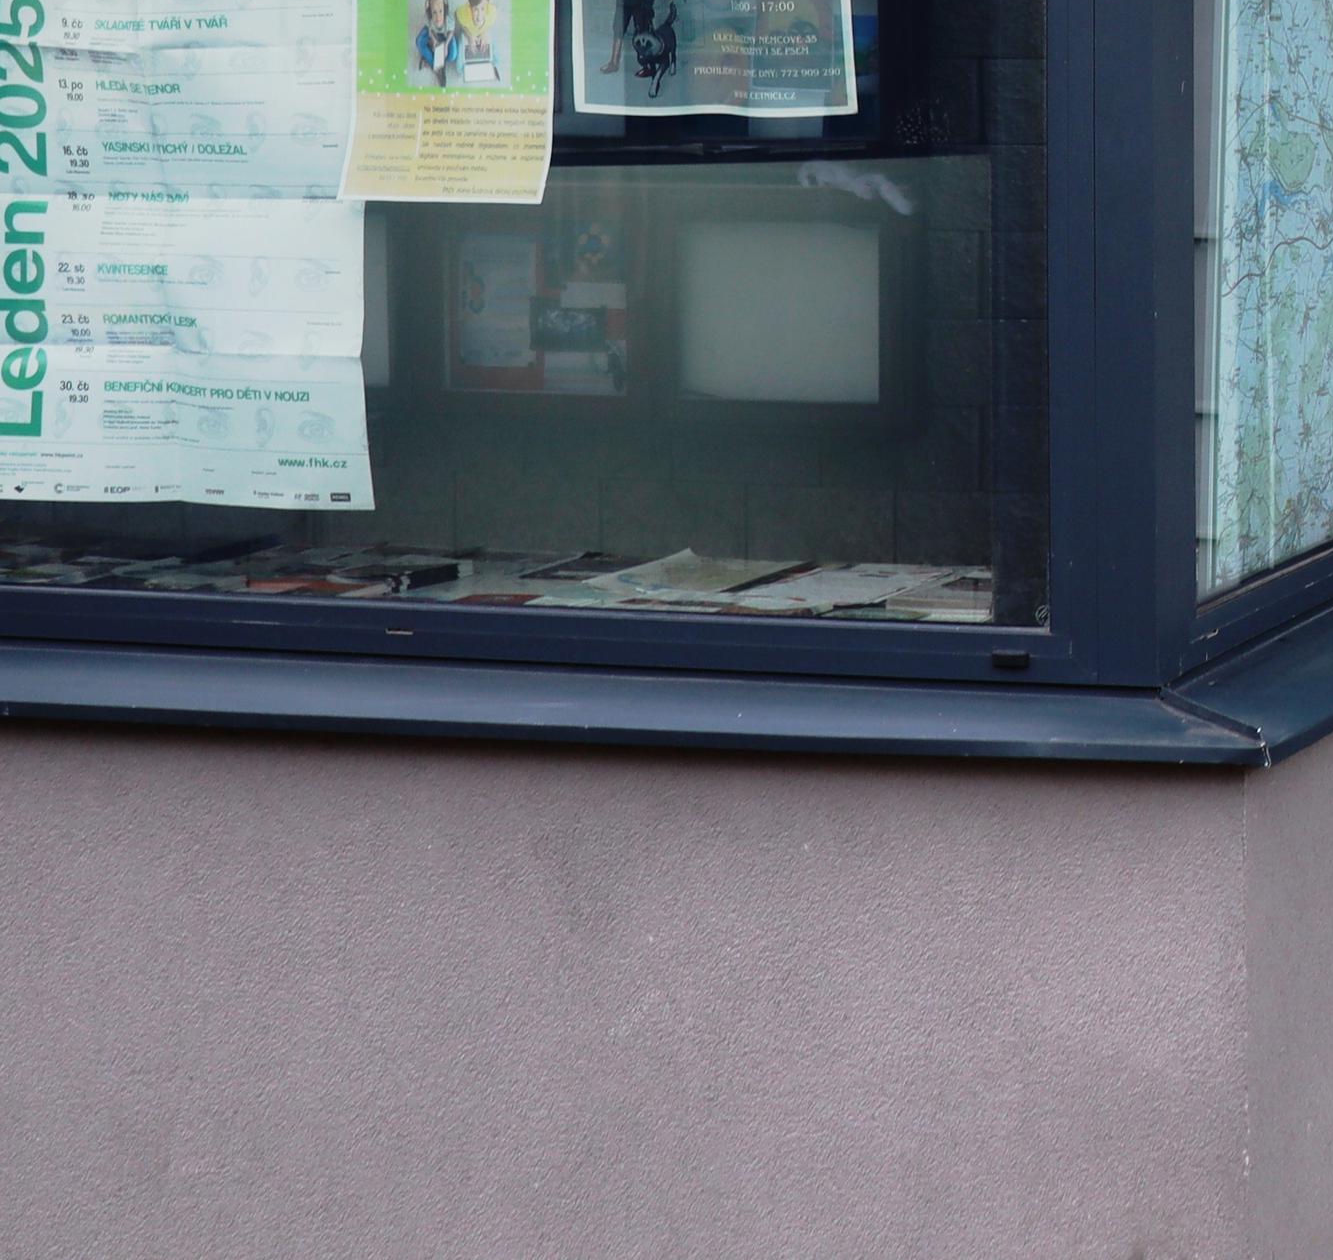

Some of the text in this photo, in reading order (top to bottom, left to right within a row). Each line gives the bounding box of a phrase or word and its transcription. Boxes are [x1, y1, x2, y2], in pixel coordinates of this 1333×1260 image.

[761, 0, 795, 13] 17:00
[149, 15, 181, 31] TVÁŘÍ
[183, 19, 192, 30] V
[196, 14, 228, 29] TVÁŘ
[58, 79, 83, 92] 13. po
[129, 82, 142, 94] SE
[142, 83, 181, 96] TENOR
[62, 145, 74, 156] 16.
[197, 142, 248, 156] DOLEŽAL
[69, 159, 90, 168] 19.30
[97, 263, 169, 276] KVINTESENCE
[0, 199, 49, 437] Leden
[61, 314, 76, 325] 23.
[102, 311, 198, 328] ROMANTICKÝ LESK
[59, 380, 75, 392] 30.
[103, 379, 164, 393] BENEFIČNÍ
[210, 388, 234, 400] PRO
[236, 386, 263, 402] DĚTI
[264, 390, 273, 402] V
[274, 391, 310, 403] NOUZI
[68, 394, 89, 404] 19.30
[278, 457, 348, 469] www.fhk.cz
